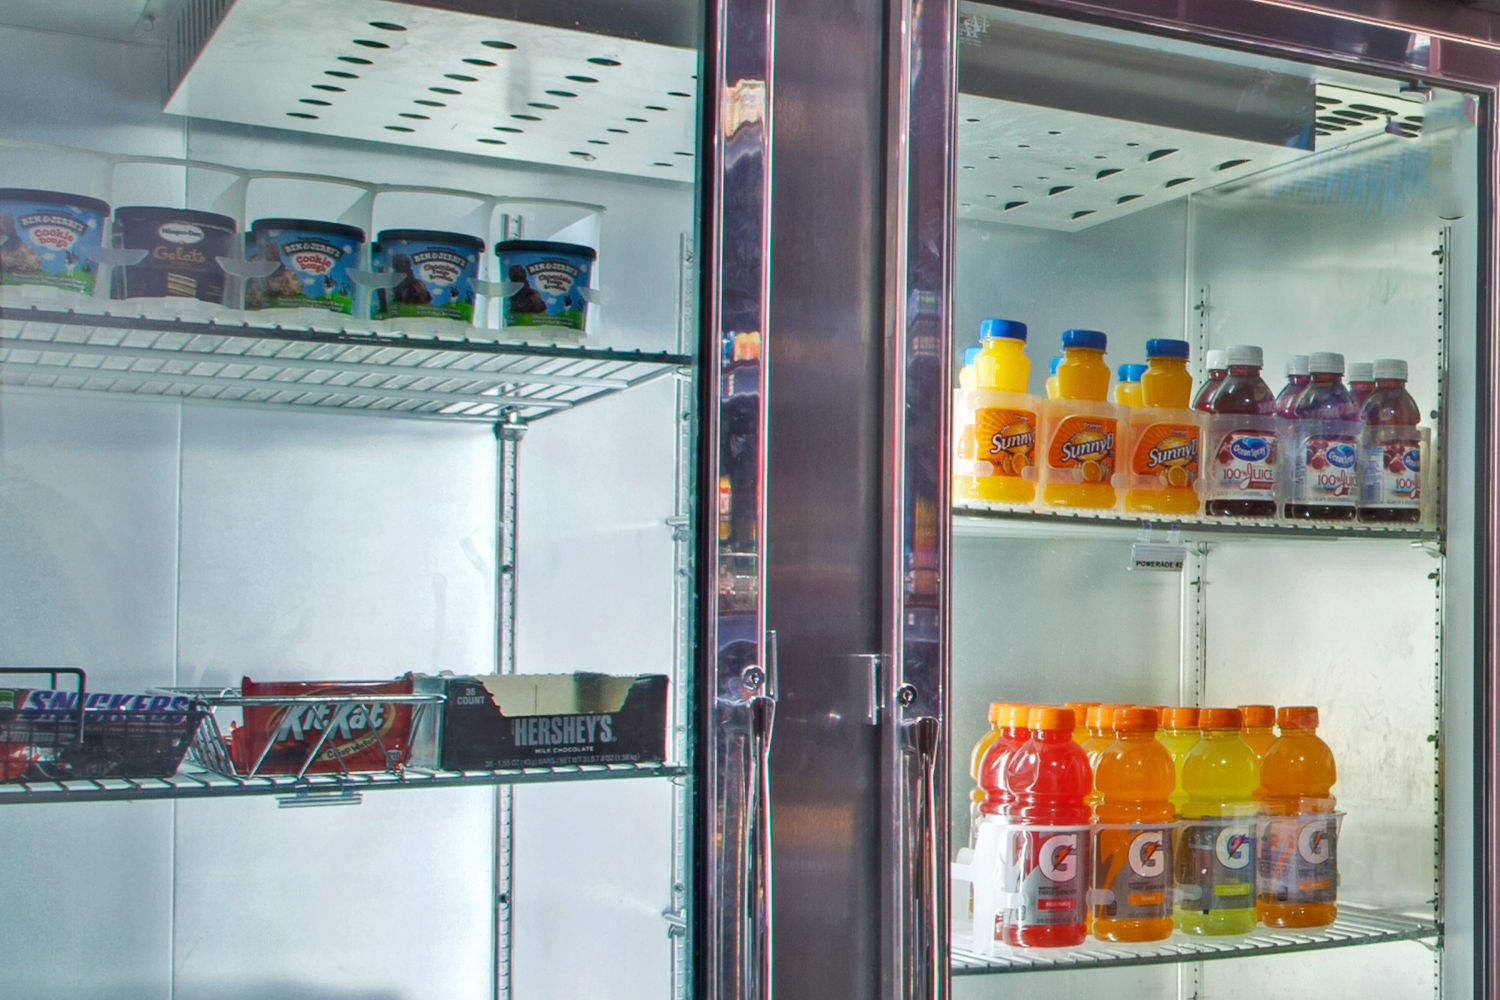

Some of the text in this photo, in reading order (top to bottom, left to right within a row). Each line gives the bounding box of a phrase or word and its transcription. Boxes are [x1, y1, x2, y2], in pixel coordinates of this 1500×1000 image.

[21, 216, 41, 226] BEN
[153, 245, 206, 264] Gelato
[285, 243, 302, 253] BEN
[414, 253, 431, 263] BEN
[529, 263, 545, 273] BEN
[990, 431, 1034, 453] Sunny
[1136, 559, 1175, 569] POWERADE
[456, 696, 485, 705] COUNT
[513, 714, 614, 746] HERSHEY'S
[552, 745, 594, 754] CHOCOLATE
[1216, 825, 1251, 870] G
[1298, 821, 1329, 865] G
[1039, 834, 1077, 882] G
[1128, 831, 1165, 877] G
